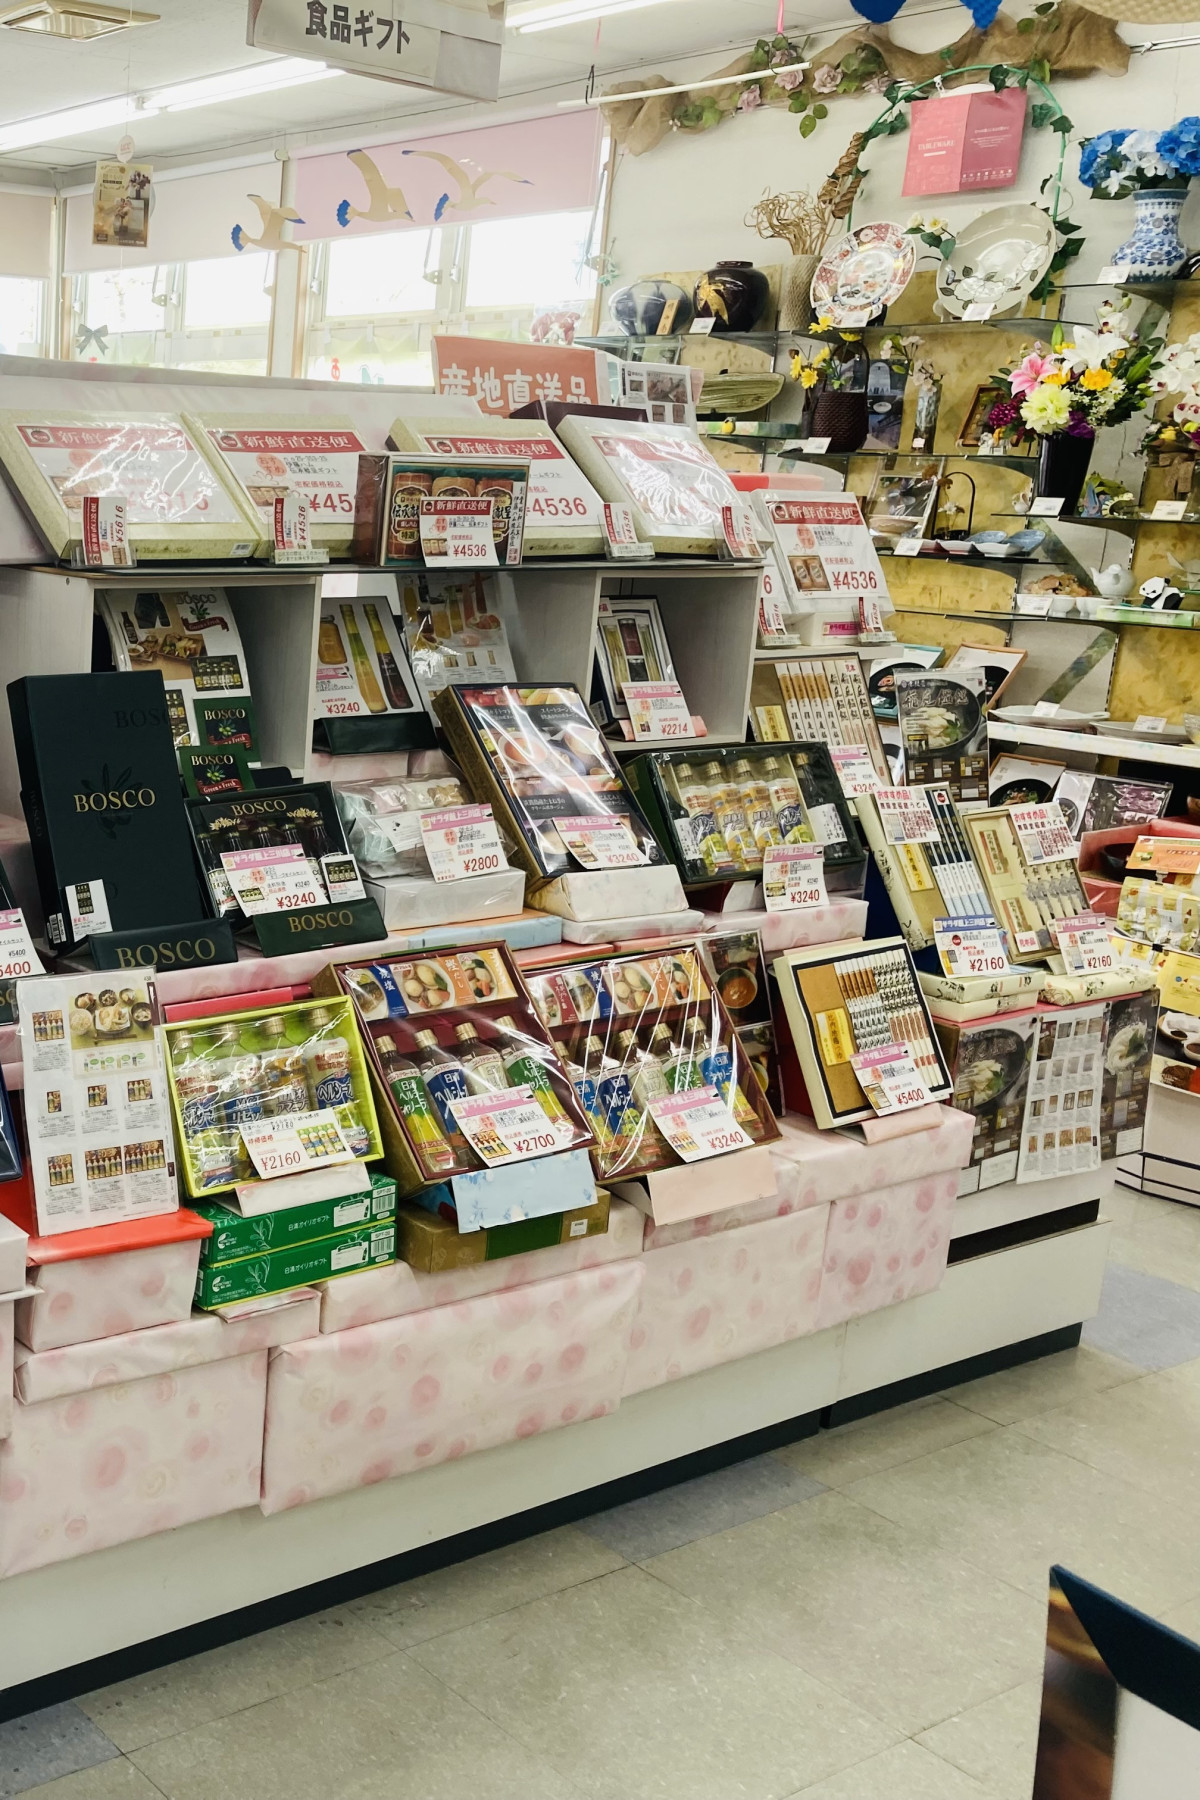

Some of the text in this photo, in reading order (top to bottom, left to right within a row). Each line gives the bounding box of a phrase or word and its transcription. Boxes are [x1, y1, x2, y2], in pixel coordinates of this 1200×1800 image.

[305, 0, 411, 54] 食品ギフト
[440, 365, 592, 405] 産地直送品
[244, 435, 352, 449] 新鮮直送便
[456, 442, 552, 457] 新鮮直送便
[436, 500, 488, 511] 新鮮直送便
[789, 505, 854, 520] 新鮮直送便
[114, 505, 125, 543] ¥5616
[298, 506, 307, 542] ¥4536
[453, 545, 487, 557] ¥4536
[832, 571, 877, 590] ¥4536
[204, 708, 246, 720] BOSCO
[326, 702, 360, 714] ¥3240
[661, 724, 688, 735] ¥2214
[191, 755, 233, 766] BOSCO
[74, 789, 156, 813] BOSCO
[231, 800, 287, 816] BOSCO
[464, 854, 499, 873] ¥2800
[607, 853, 640, 864] ¥3240
[276, 892, 316, 908] ¥3240
[791, 890, 820, 904] ¥3240
[288, 910, 353, 932] BOSCO
[8, 949, 26, 957] ¥5400
[116, 937, 216, 969] BOSCO
[970, 957, 1004, 972] ¥2160
[1087, 956, 1112, 969] ¥2160
[896, 1088, 925, 1105] ¥5400
[514, 1133, 555, 1153] ¥2700
[708, 1132, 744, 1149] ¥3240
[261, 1151, 301, 1171] ¥2160
[288, 1215, 330, 1231] 日清オイリオギフト
[285, 1258, 328, 1275] 日清オイリオギフト
